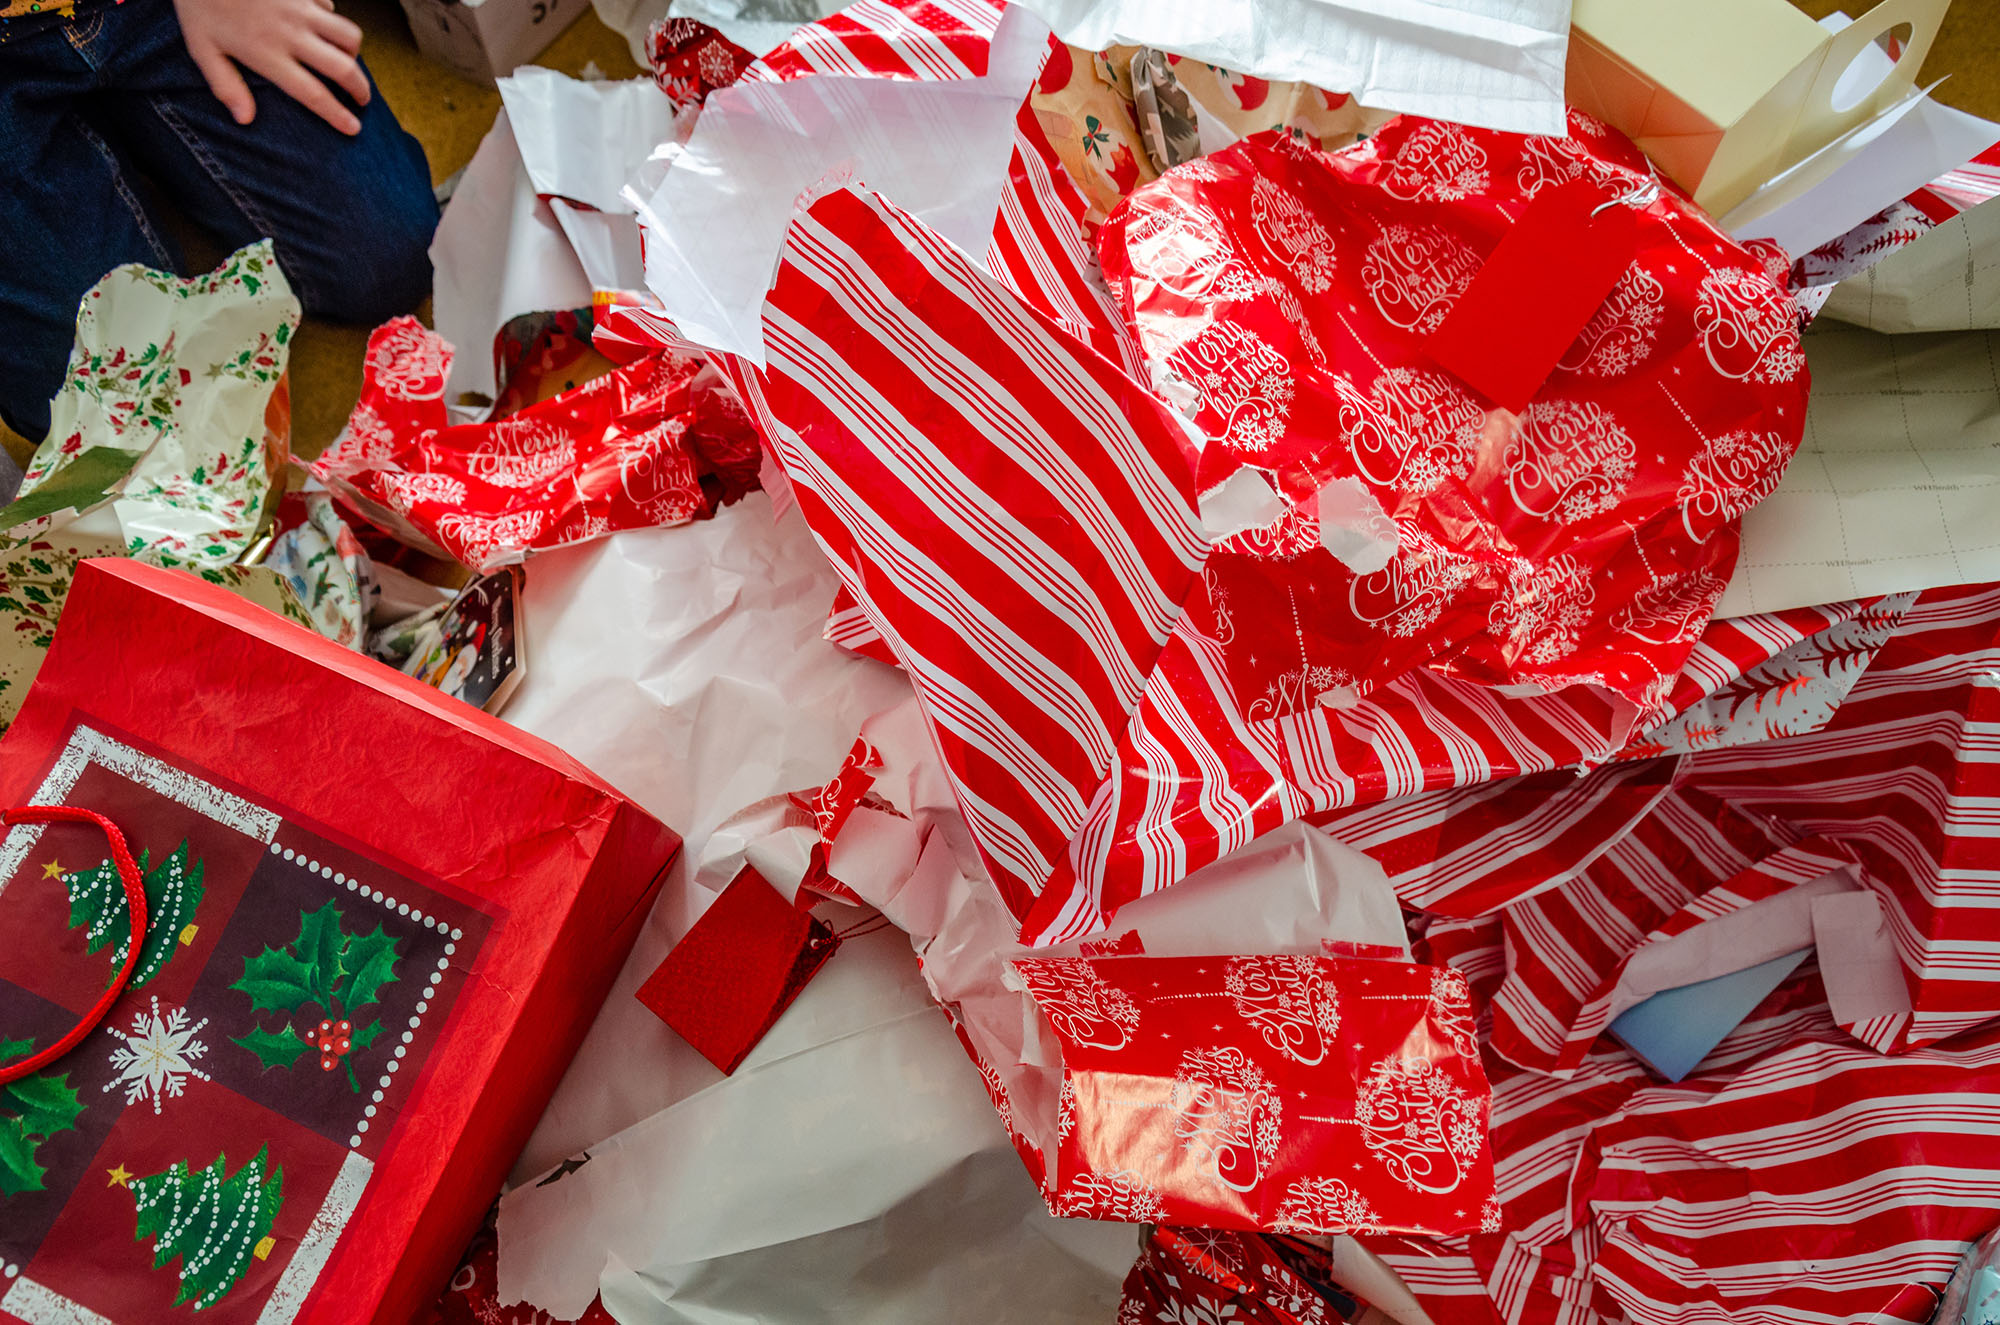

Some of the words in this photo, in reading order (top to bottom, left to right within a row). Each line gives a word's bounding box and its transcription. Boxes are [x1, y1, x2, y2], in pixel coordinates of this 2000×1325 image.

[1362, 225, 1457, 289] Merry
[1158, 319, 1256, 378] Merry
[1503, 401, 1606, 472] Merry
[1509, 422, 1636, 517] Christmas
[1677, 431, 1782, 500] Merry
[1268, 955, 1324, 1066] Christm
[1174, 1050, 1220, 1177] Merry
[1206, 1047, 1269, 1193] Christmas
[1354, 1061, 1411, 1183] Merry
[1398, 1056, 1462, 1194] Christmas
